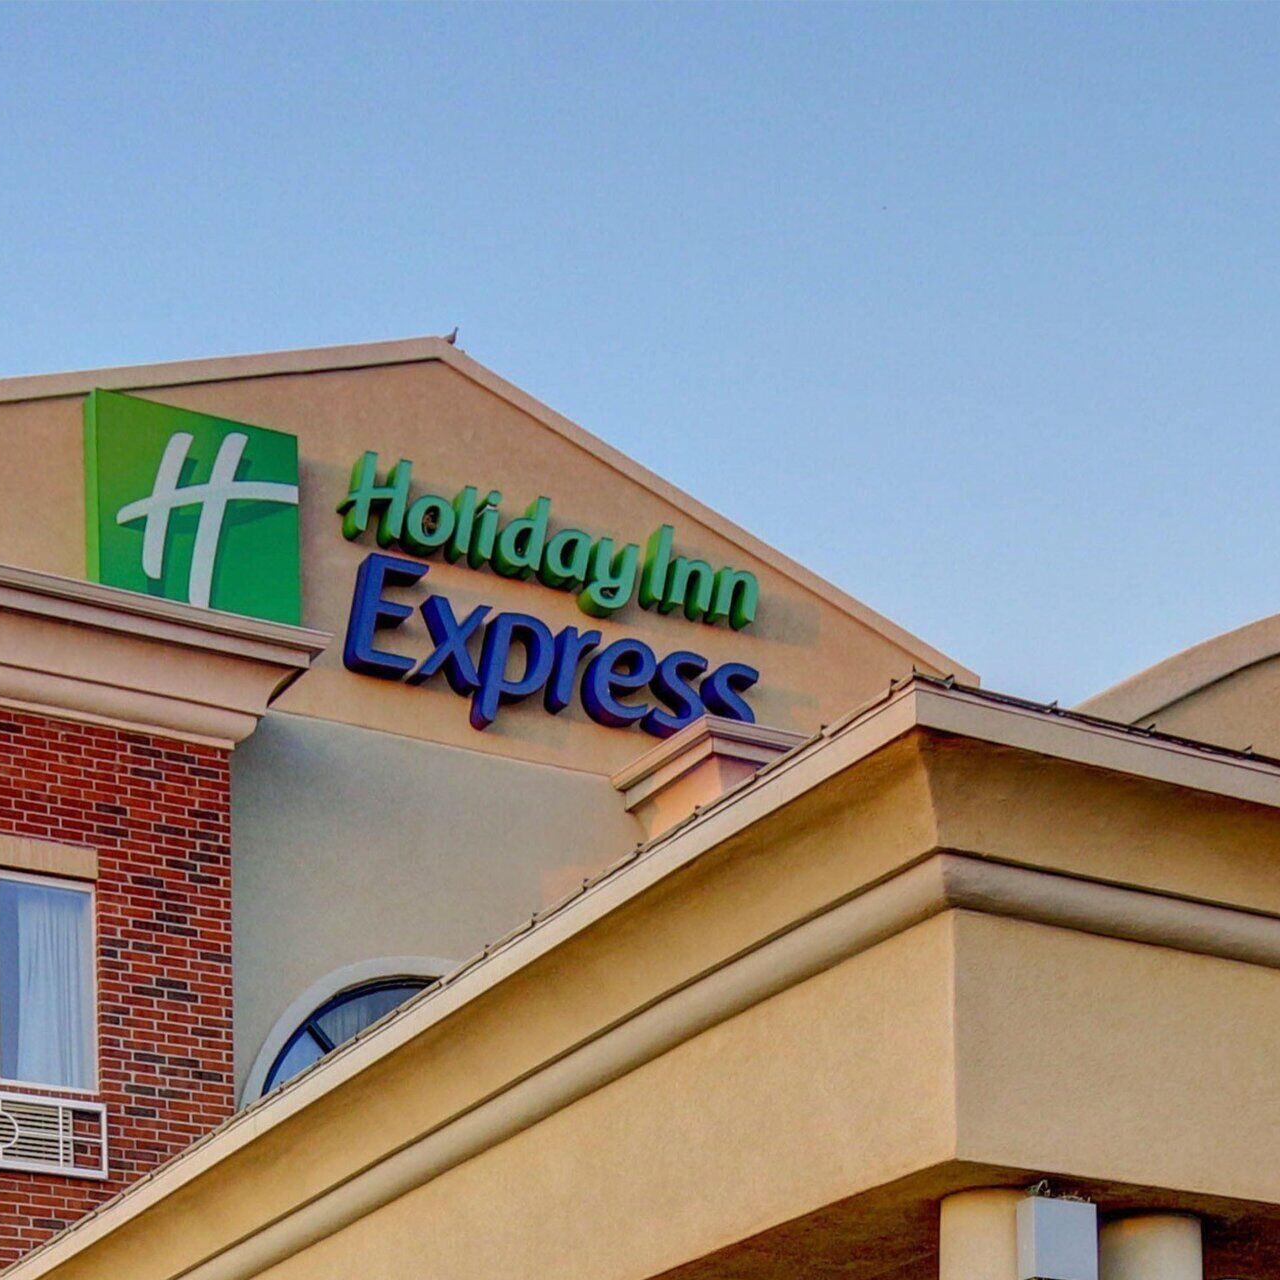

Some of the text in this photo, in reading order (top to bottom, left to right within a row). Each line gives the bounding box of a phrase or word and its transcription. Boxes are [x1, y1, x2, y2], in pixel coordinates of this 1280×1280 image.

[336, 450, 761, 632] Holiday Inn
[343, 552, 760, 739] Express
